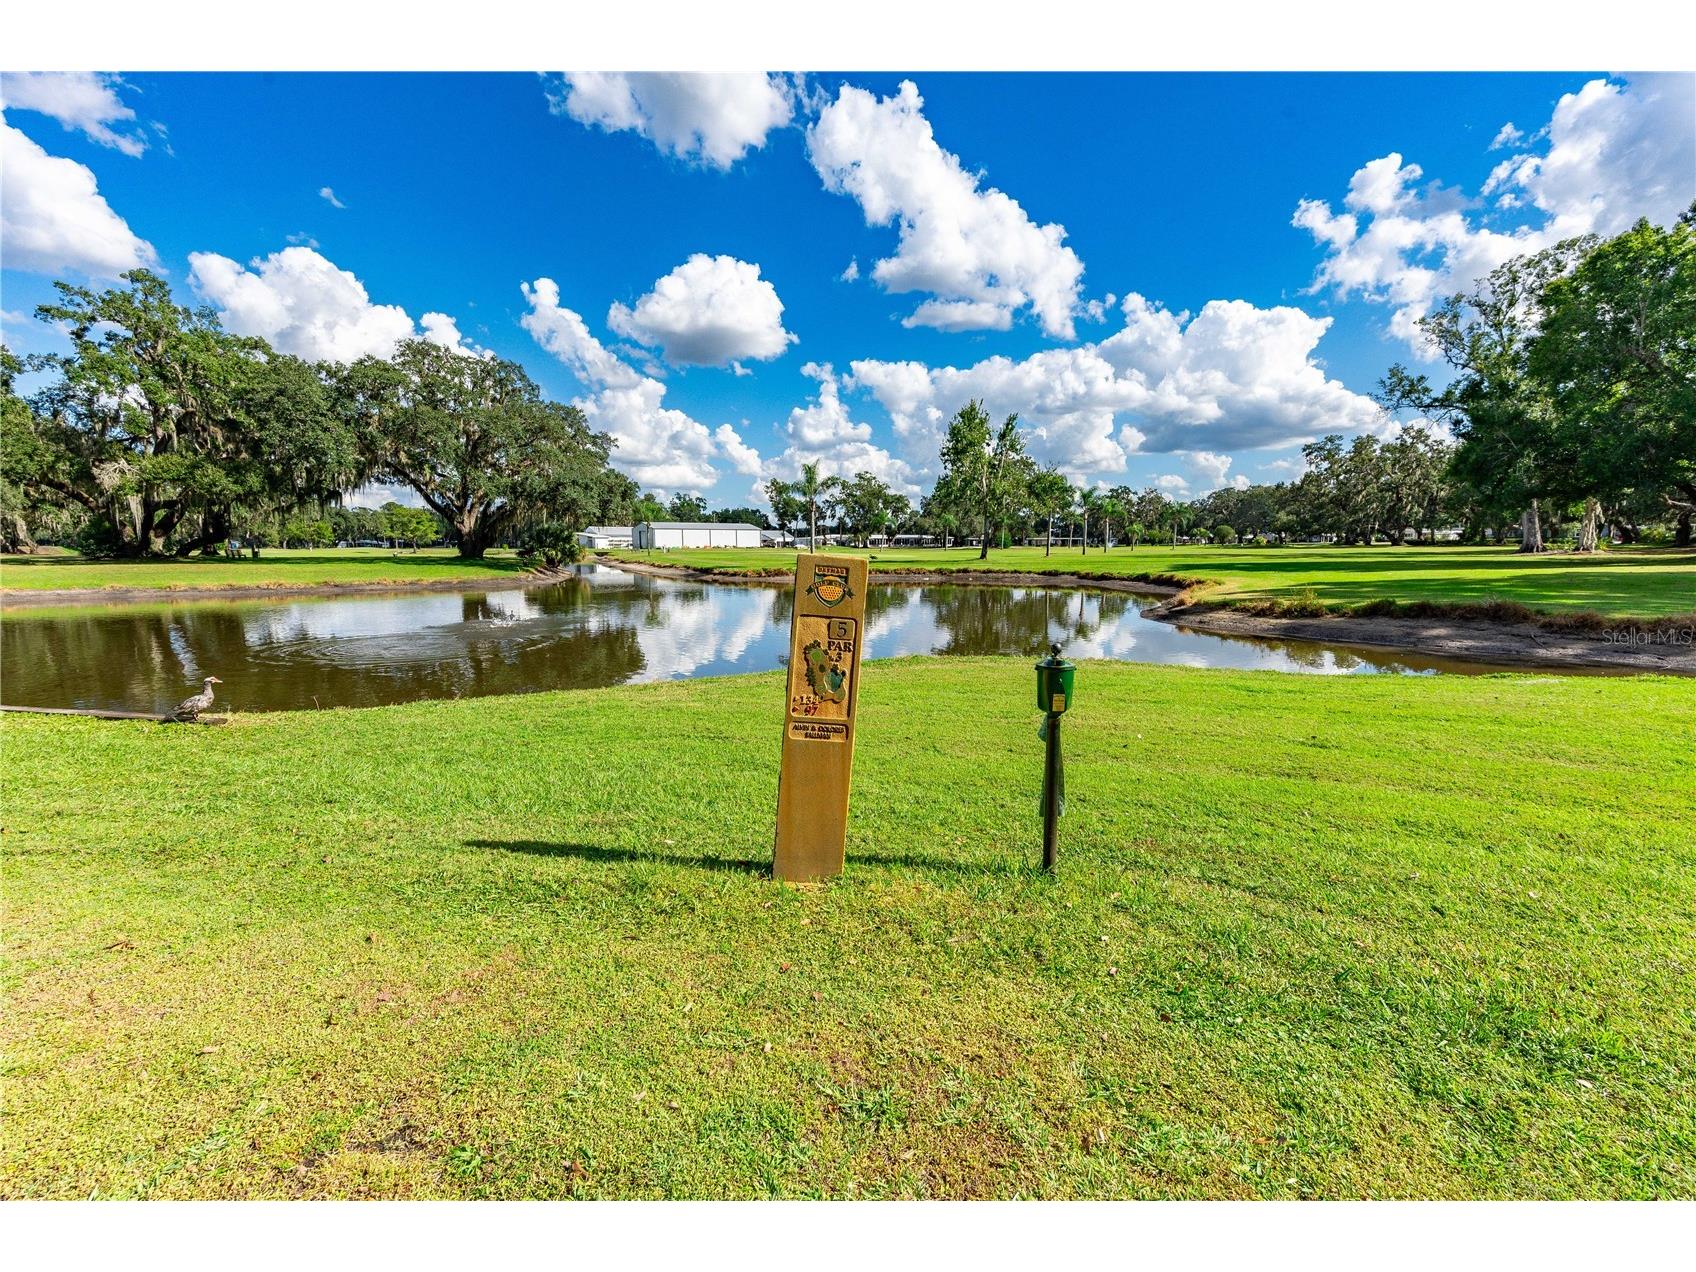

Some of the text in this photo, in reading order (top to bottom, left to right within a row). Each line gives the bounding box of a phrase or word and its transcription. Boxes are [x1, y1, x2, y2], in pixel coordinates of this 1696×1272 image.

[837, 622, 847, 637] 5
[828, 641, 853, 653] PAR
[835, 652, 843, 662] 3
